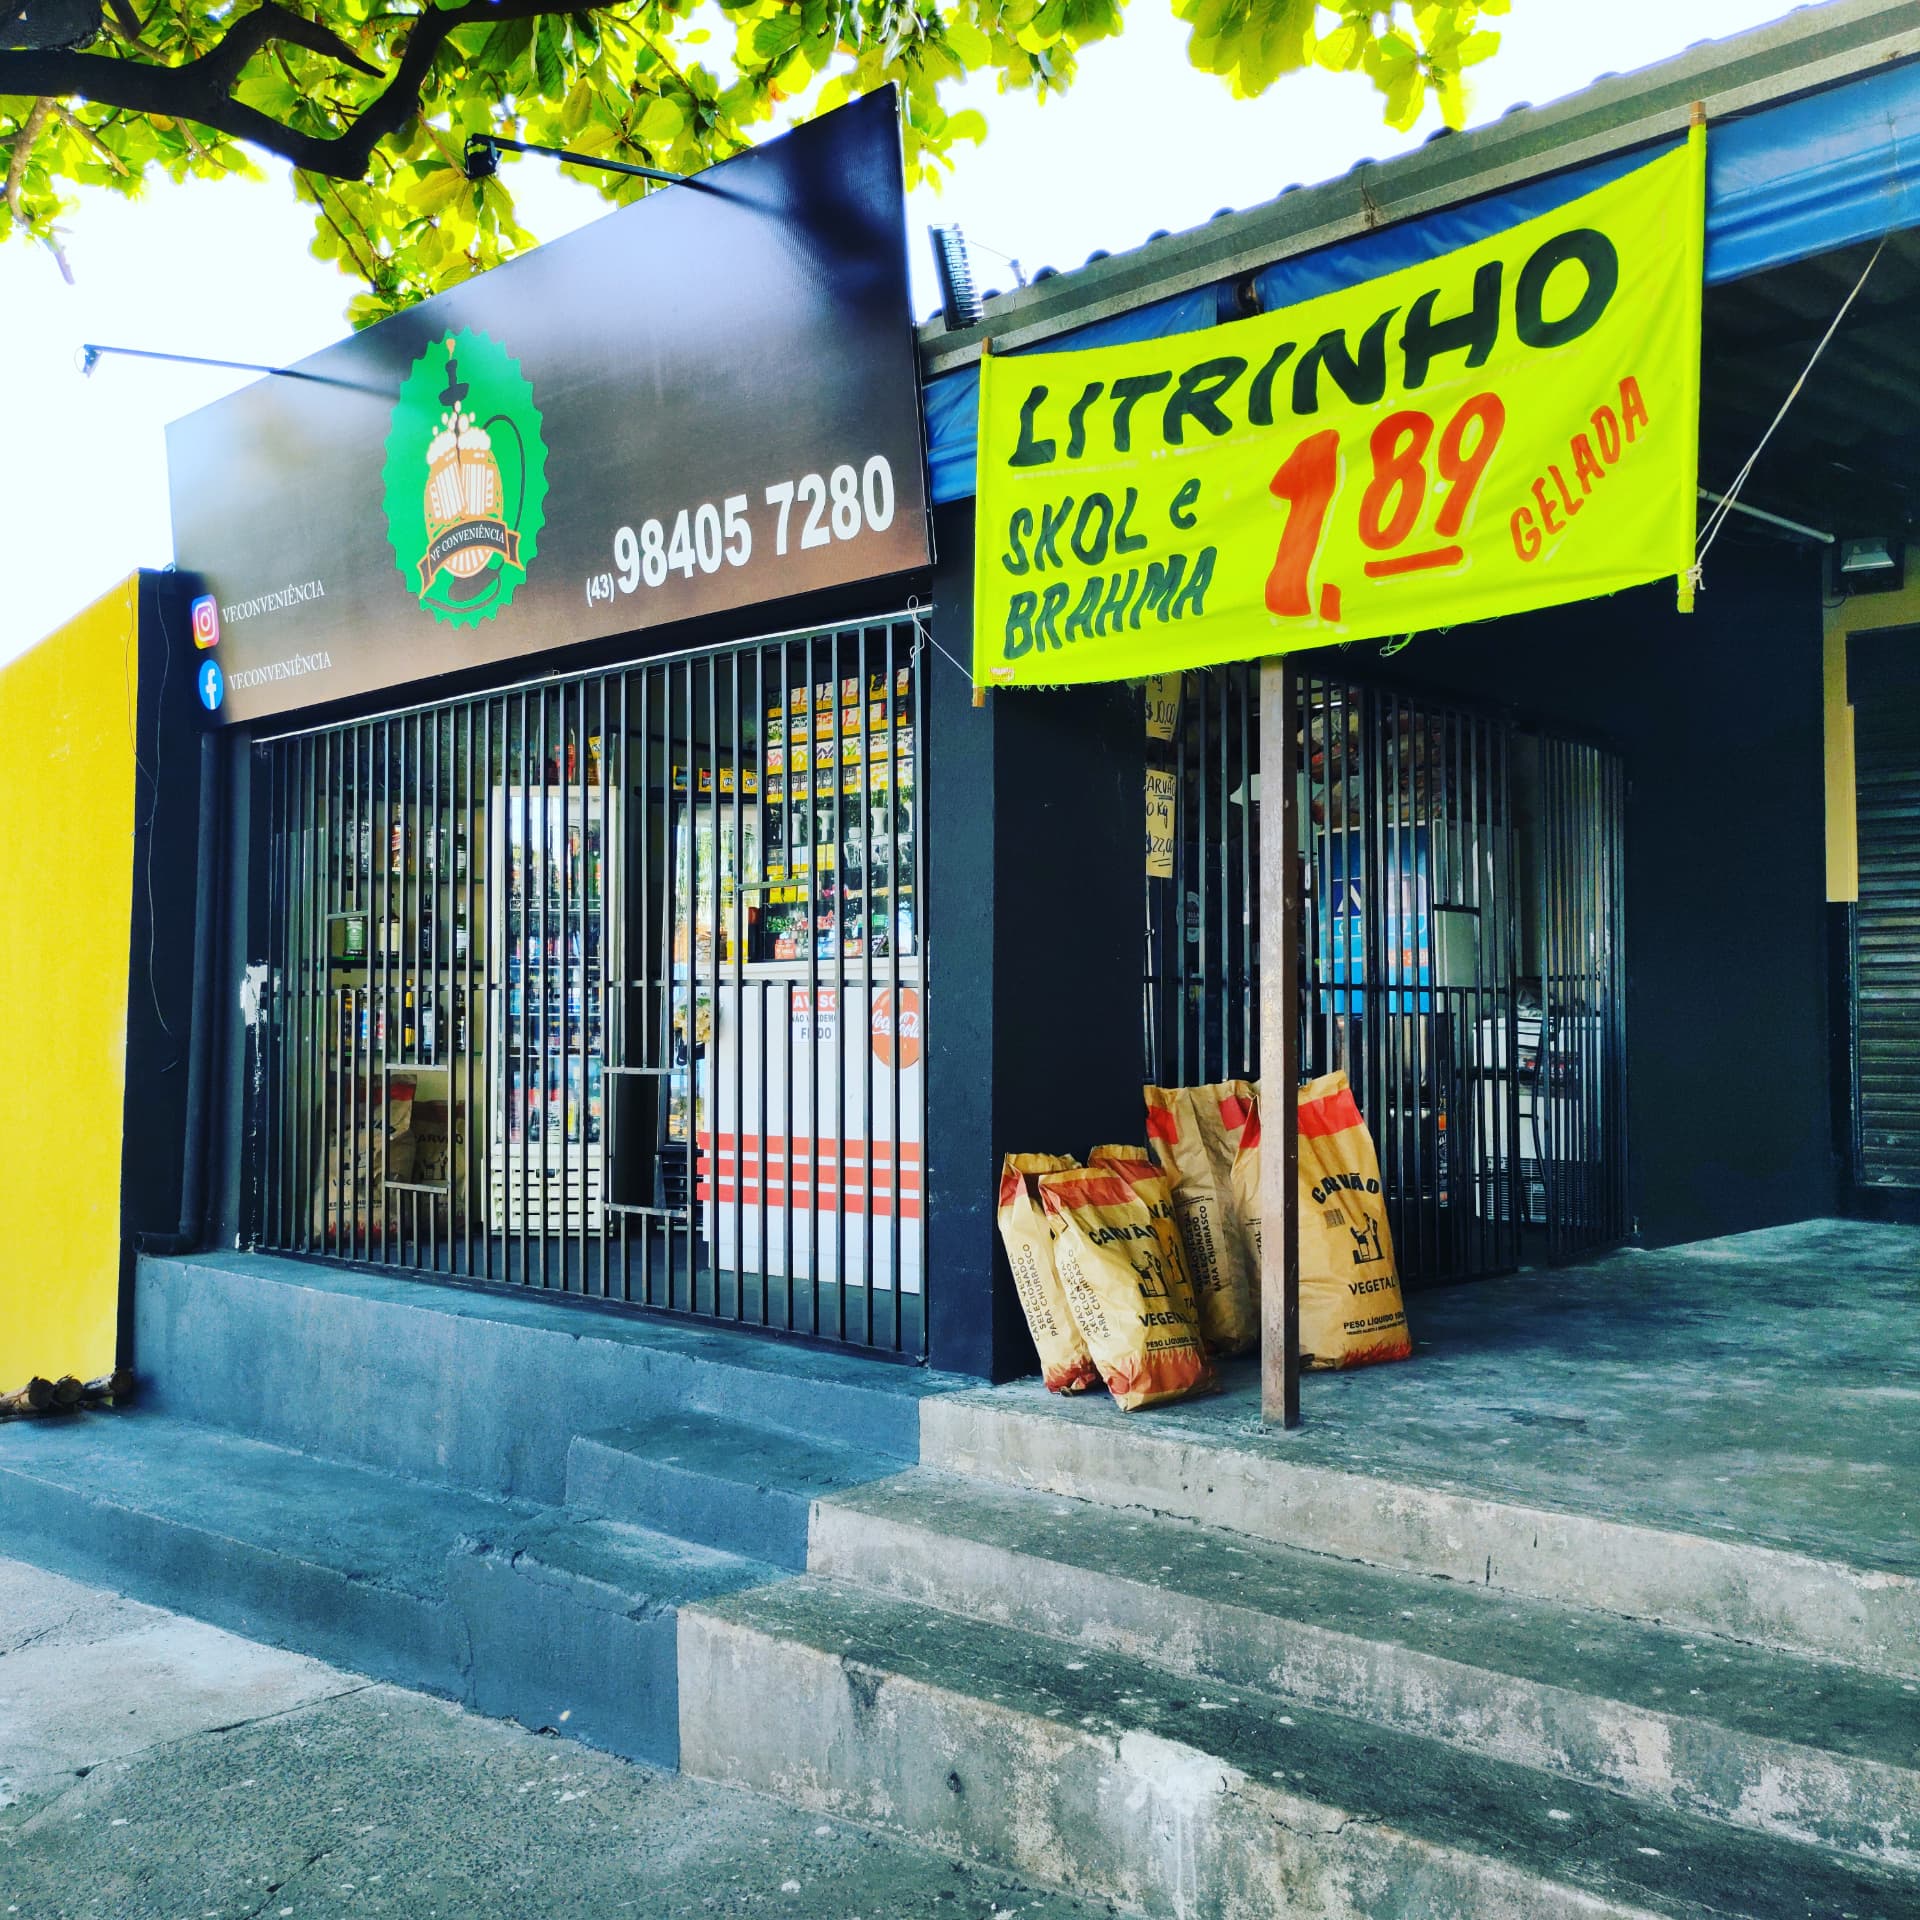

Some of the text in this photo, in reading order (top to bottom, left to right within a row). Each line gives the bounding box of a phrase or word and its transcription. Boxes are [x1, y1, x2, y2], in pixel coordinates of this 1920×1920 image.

[1008, 228, 1618, 467] LITRINHO
[1510, 376, 1648, 562] GELADA
[430, 524, 505, 561] VF CONVENIÊNCIA
[586, 455, 895, 608] (43) 98405 7280
[1002, 478, 1201, 575] SKOL e
[1003, 546, 1217, 660] BRAHMA
[1200, 1205, 1216, 1265] CHURRASCO
[1023, 1244, 1059, 1337] PARA CHURRASCO
[1344, 1320, 1366, 1329] PESO
[1348, 1276, 1396, 1296] VEGETAL
[1146, 1339, 1164, 1349] PESO
